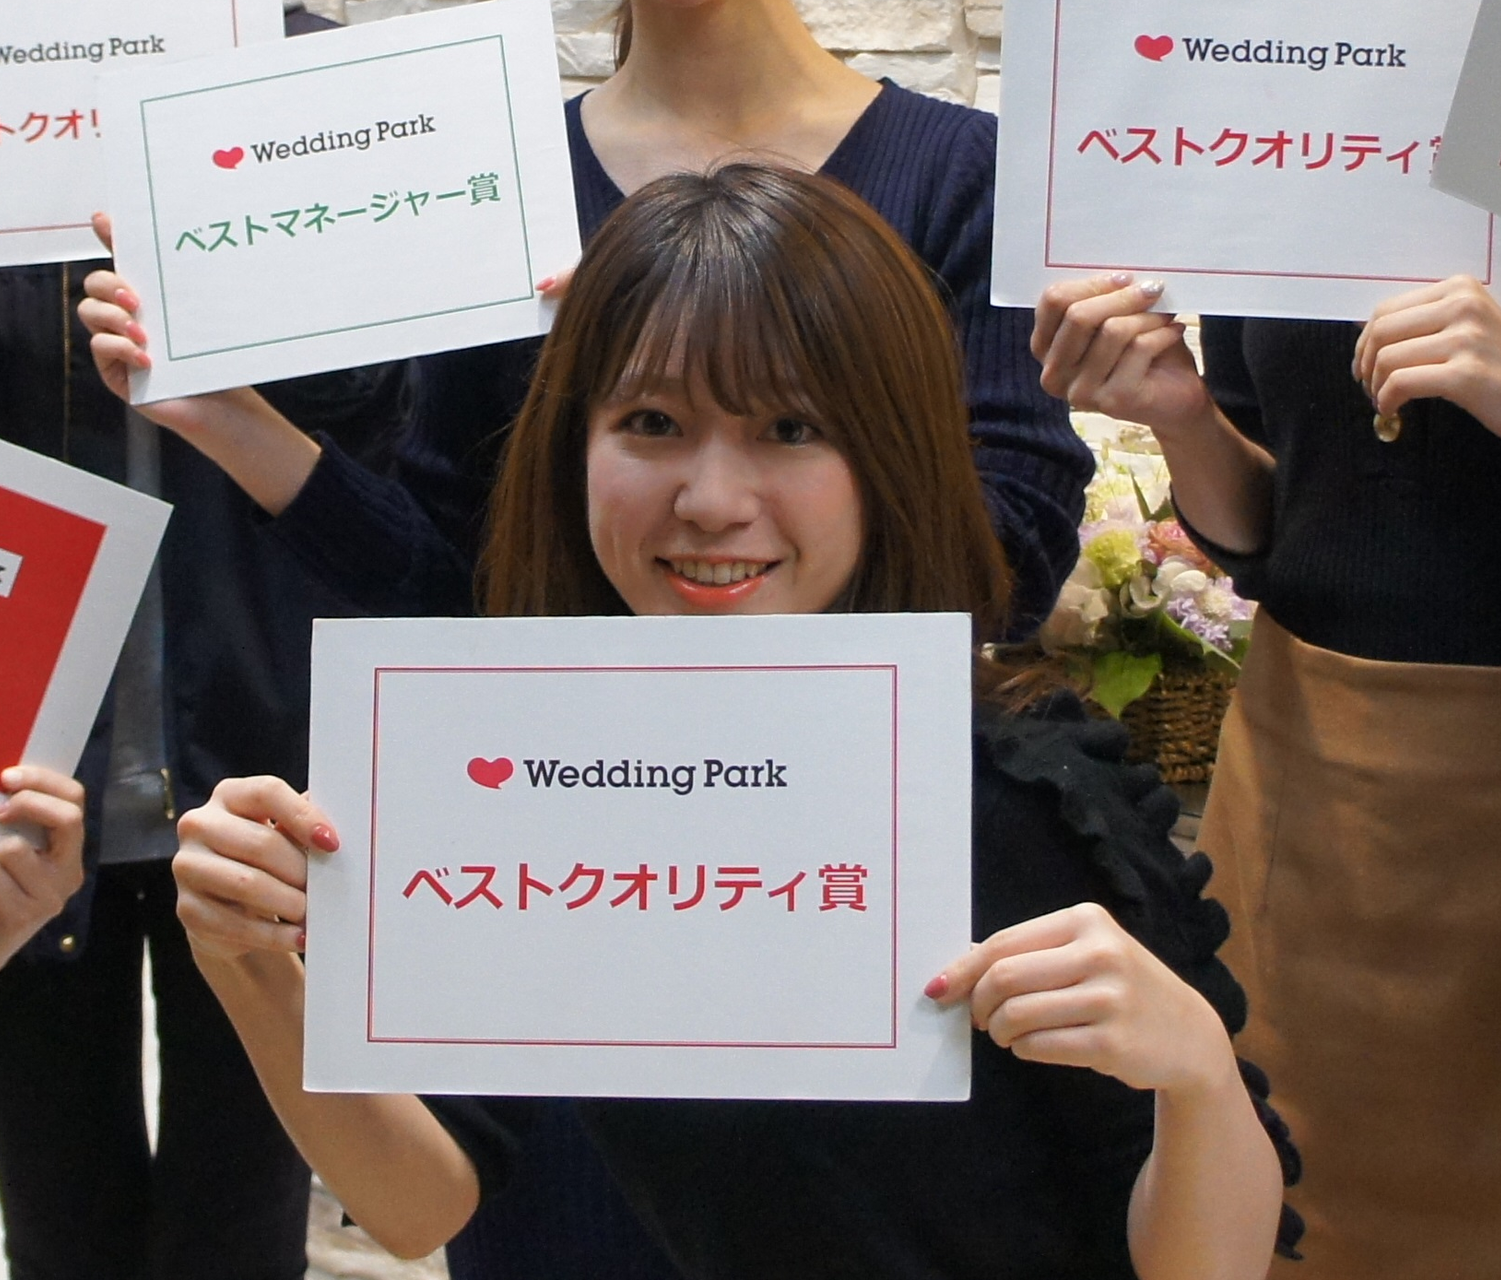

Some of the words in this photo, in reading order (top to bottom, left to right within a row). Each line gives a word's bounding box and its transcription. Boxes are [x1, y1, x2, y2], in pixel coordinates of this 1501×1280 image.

[108, 33, 166, 58] Park
[1181, 36, 1330, 72] Wedding
[1333, 40, 1407, 68] Park
[249, 127, 372, 164] Wedding
[374, 112, 437, 142] Park
[1076, 126, 1444, 175] ベストクオリティ
[174, 171, 501, 254] ベストマネージャー賞
[522, 758, 698, 796] Wedding
[702, 758, 789, 788] Park
[401, 861, 870, 913] ベストクオリティ賞
